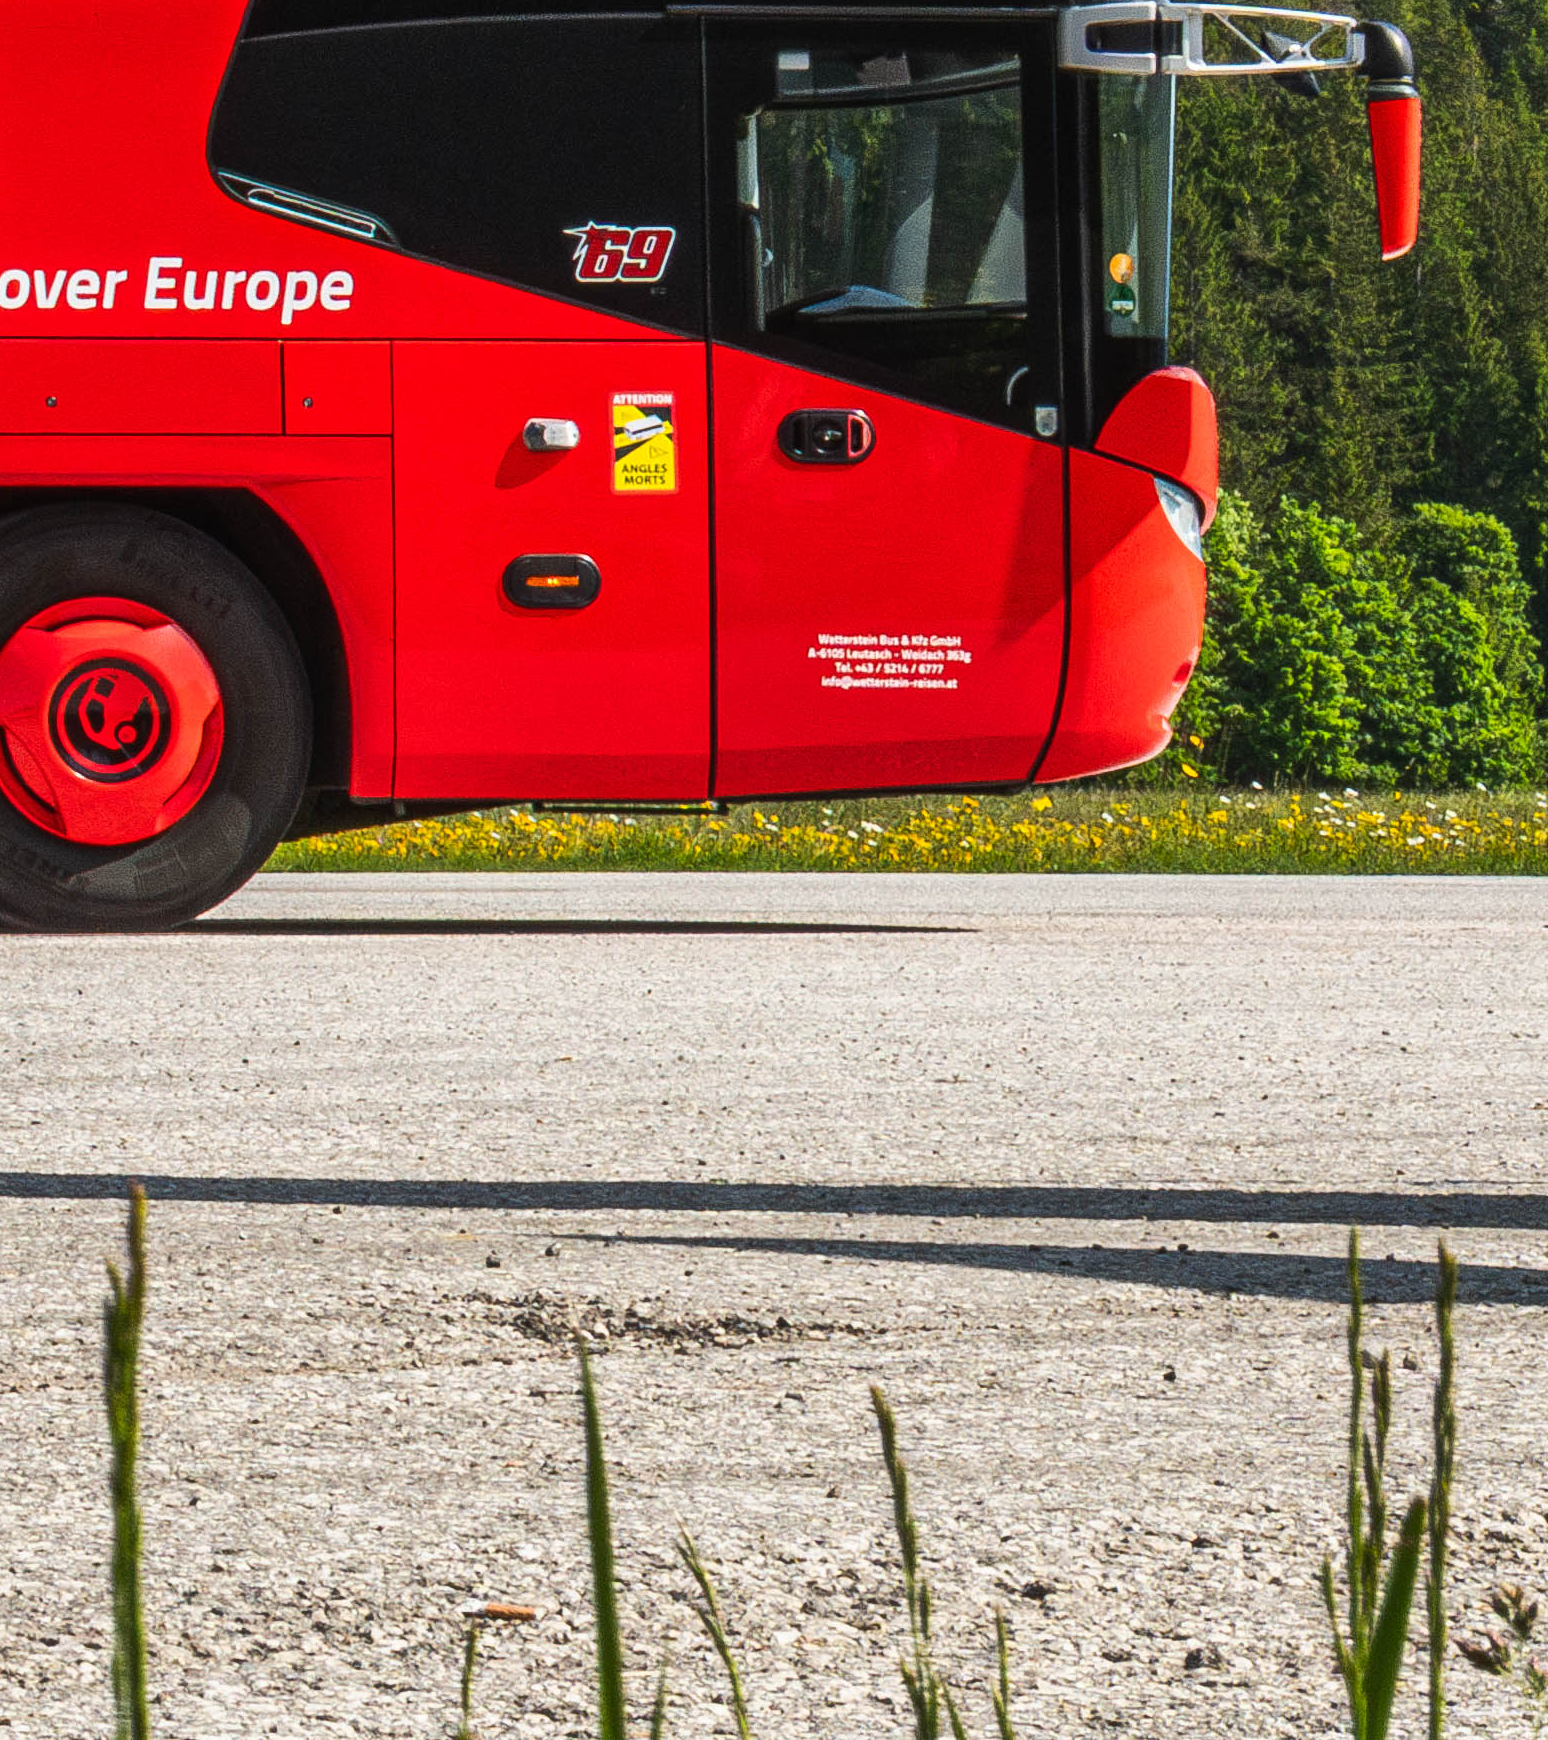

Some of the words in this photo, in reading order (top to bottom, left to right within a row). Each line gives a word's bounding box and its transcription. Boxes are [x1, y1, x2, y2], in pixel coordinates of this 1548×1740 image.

[562, 221, 676, 283] 69
[143, 256, 354, 326] Europe
[612, 393, 673, 405] ATTENTION
[621, 463, 668, 474] ANGLES
[624, 475, 666, 485] MORTS
[817, 633, 879, 646] Wetterstein
[879, 634, 899, 646] Bus
[901, 635, 910, 646] &
[911, 635, 929, 647] Kfz
[930, 635, 962, 647] GmbH
[807, 647, 846, 659] A-6105
[846, 648, 893, 660] Leutasch
[900, 649, 945, 661] Weidach
[834, 661, 854, 673] Tel.
[883, 662, 910, 674] 5214
[917, 663, 944, 675] 6777
